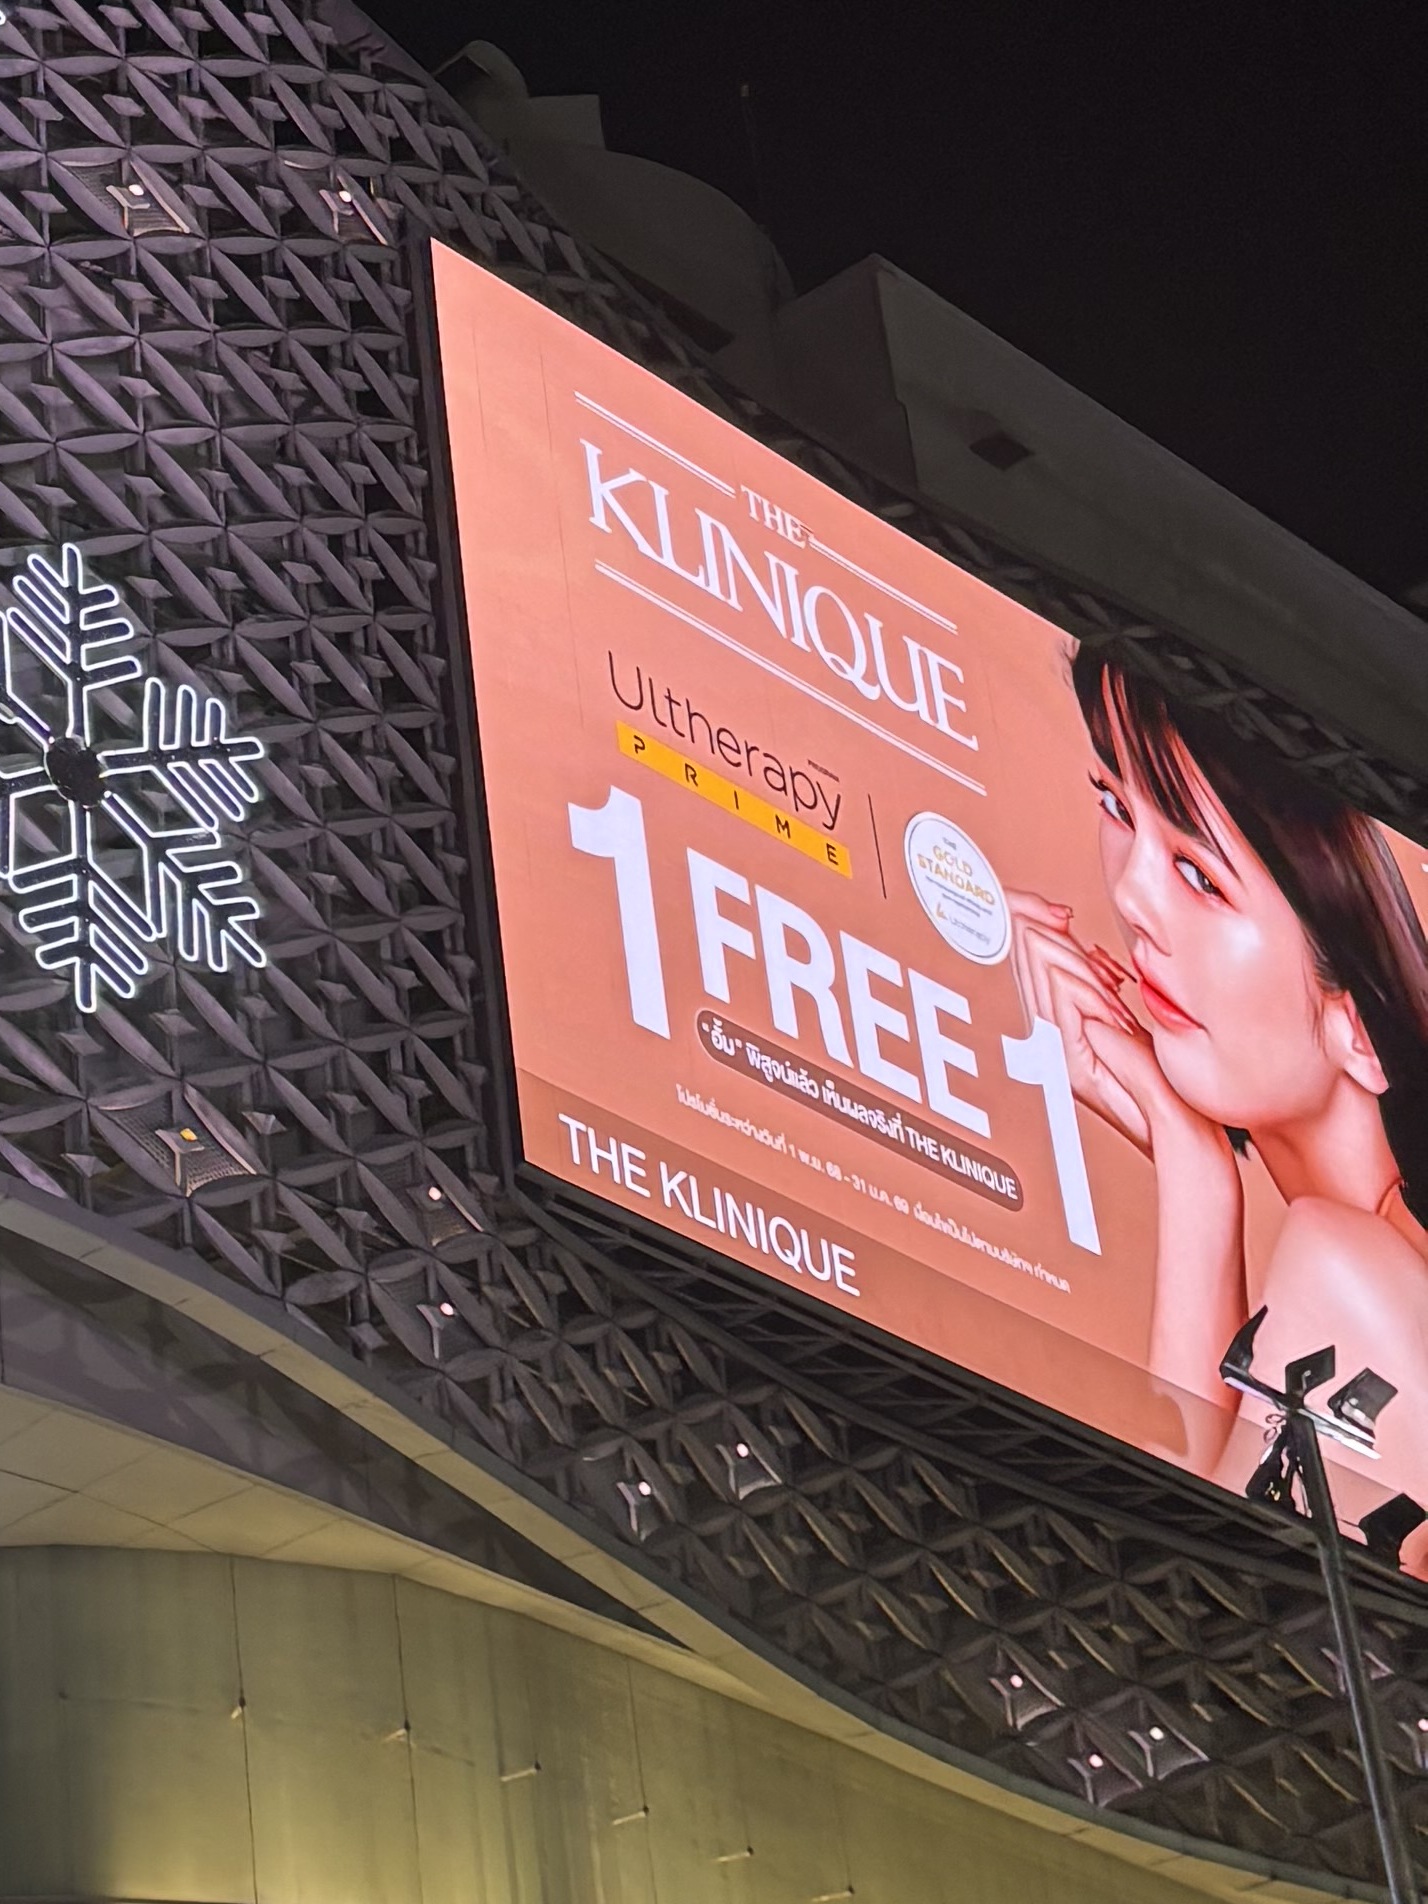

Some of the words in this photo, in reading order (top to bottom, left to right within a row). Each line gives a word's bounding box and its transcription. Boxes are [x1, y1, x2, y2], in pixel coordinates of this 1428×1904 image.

[741, 485, 812, 549] THE
[580, 439, 979, 751] KLINIQUE
[608, 650, 841, 831] Ultherapy
[633, 735, 839, 866] PRIME
[917, 853, 996, 906] STANDARD
[932, 845, 973, 878] GOLD
[568, 785, 670, 1040] 1
[686, 847, 991, 1139] FREE
[1001, 1016, 1102, 1256] 1
[557, 1112, 652, 1199] THE
[659, 1160, 862, 1298] KLINIQUE
[904, 1126, 940, 1159] THE
[941, 1144, 1018, 1201] KLINIQUE
